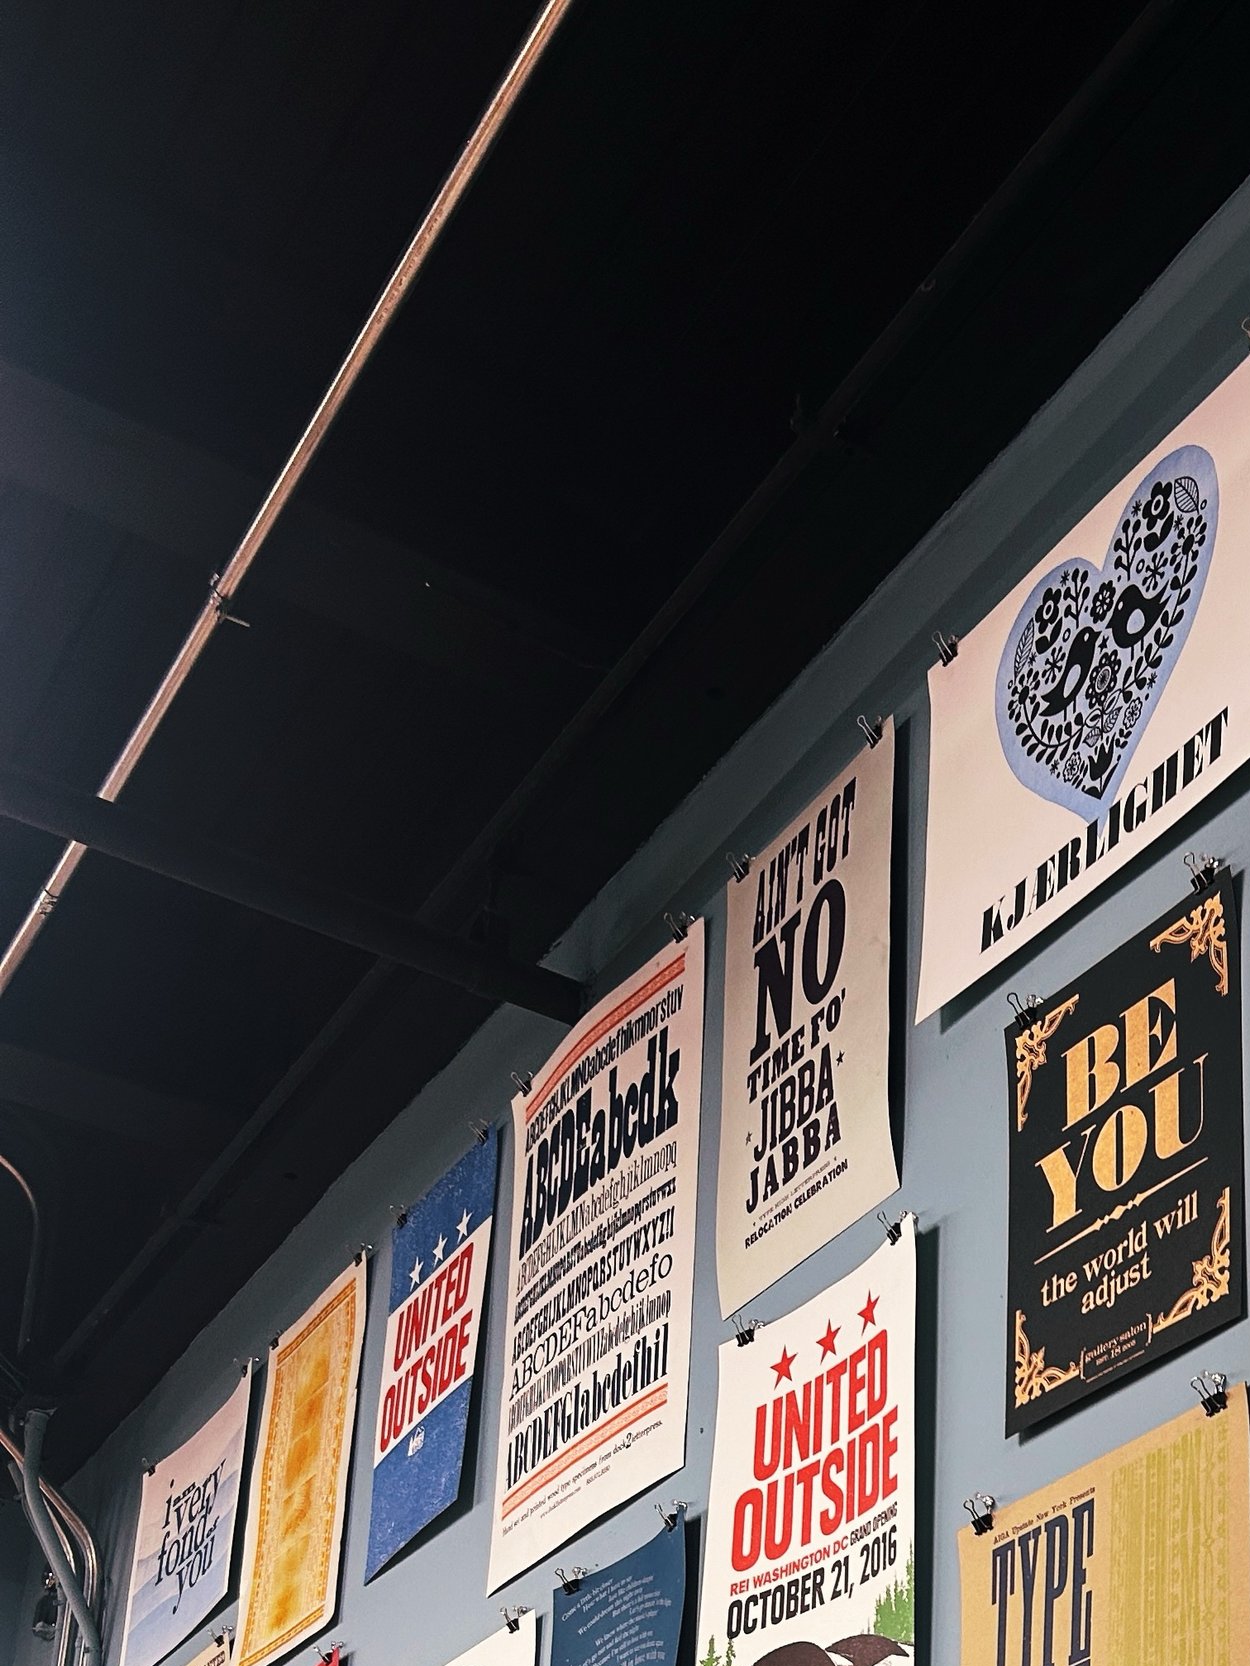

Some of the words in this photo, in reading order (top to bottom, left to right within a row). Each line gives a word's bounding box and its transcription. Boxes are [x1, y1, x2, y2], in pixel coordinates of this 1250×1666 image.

[752, 824, 808, 948] AIN'T
[812, 775, 857, 885] GOT
[749, 878, 847, 1067] NO
[747, 1025, 806, 1104] TIME
[810, 988, 846, 1049] FO'
[753, 1042, 834, 1162] JIBBA
[1061, 978, 1177, 1132] BE
[746, 1100, 841, 1214] JABBA
[1034, 1052, 1209, 1233] YOU
[744, 1201, 793, 1249] RELOCATION
[794, 1157, 849, 1209] CELEBRATION
[1040, 1271, 1078, 1307] the
[1082, 1221, 1148, 1282] world
[1153, 1190, 1199, 1240] will
[394, 1241, 474, 1372] UNITED
[1081, 1251, 1152, 1315] adjust
[380, 1310, 473, 1454] OUTSIDE
[754, 1329, 887, 1481] UNITED
[176, 1458, 226, 1527] very
[731, 1404, 898, 1572] OUTSIDE
[154, 1514, 207, 1587] fond
[172, 1541, 216, 1615] you
[727, 1566, 825, 1641] OCTOBER
[831, 1555, 854, 1599] 21,
[860, 1525, 897, 1585] 2016
[730, 1574, 749, 1596] REI
[753, 1548, 830, 1589] WASHINGTON
[833, 1535, 849, 1560] DC
